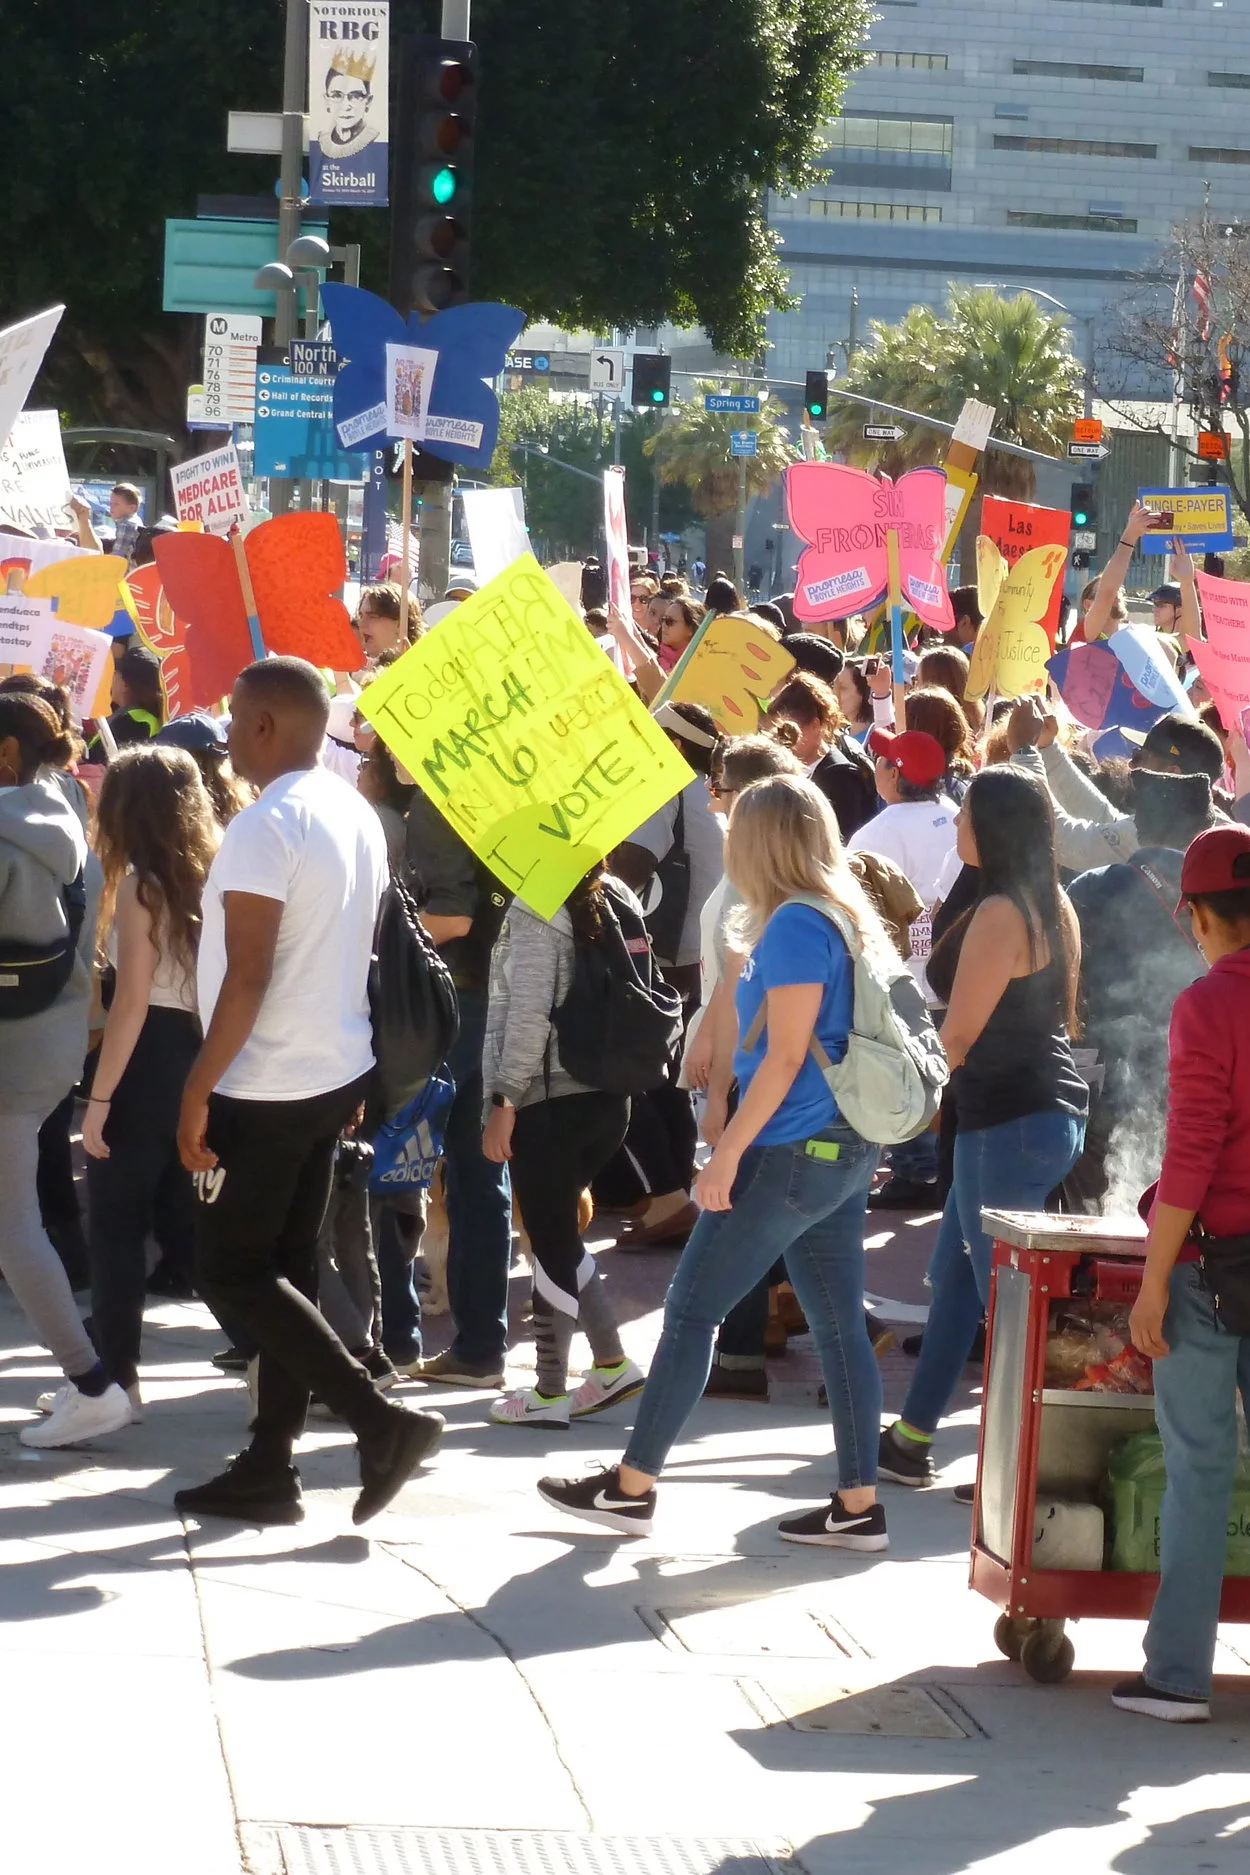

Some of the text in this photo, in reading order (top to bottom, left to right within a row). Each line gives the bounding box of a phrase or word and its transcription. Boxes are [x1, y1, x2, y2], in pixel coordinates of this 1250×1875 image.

[313, 6, 387, 17] NOTORIOUS
[319, 20, 380, 41] RBG
[322, 171, 376, 188] Skirball
[230, 332, 259, 342] Metro
[208, 345, 223, 356] 70
[293, 343, 337, 362] North
[207, 358, 220, 368] 71
[294, 361, 328, 375] 100 N
[505, 356, 533, 369] ASE
[207, 370, 220, 381] 76
[272, 375, 307, 384] Criminal
[206, 382, 221, 393] 78
[205, 394, 220, 405] 79
[271, 391, 333, 402] Hall of Records
[709, 398, 755, 410] Spring St
[205, 406, 221, 417] 96
[271, 408, 295, 418] Grand
[296, 409, 325, 419] Central
[445, 429, 476, 443] HEIGHTS
[868, 427, 895, 437] ONE WAY
[180, 452, 230, 481] FIGHT TO WIN
[178, 469, 238, 507] MEDICARE
[180, 489, 241, 521] FOR ALL!
[872, 489, 906, 518] SIN
[1144, 498, 1224, 513] SINGLE-PAYER
[1008, 513, 1033, 536] Las
[807, 569, 863, 599] promesa
[814, 578, 865, 602] BOYLE HEIGHTS
[376, 648, 472, 739] Today
[421, 670, 536, 798] MARCH
[485, 834, 541, 892] I
[1140, 864, 1163, 889] Canon
[379, 1155, 435, 1184] adida
